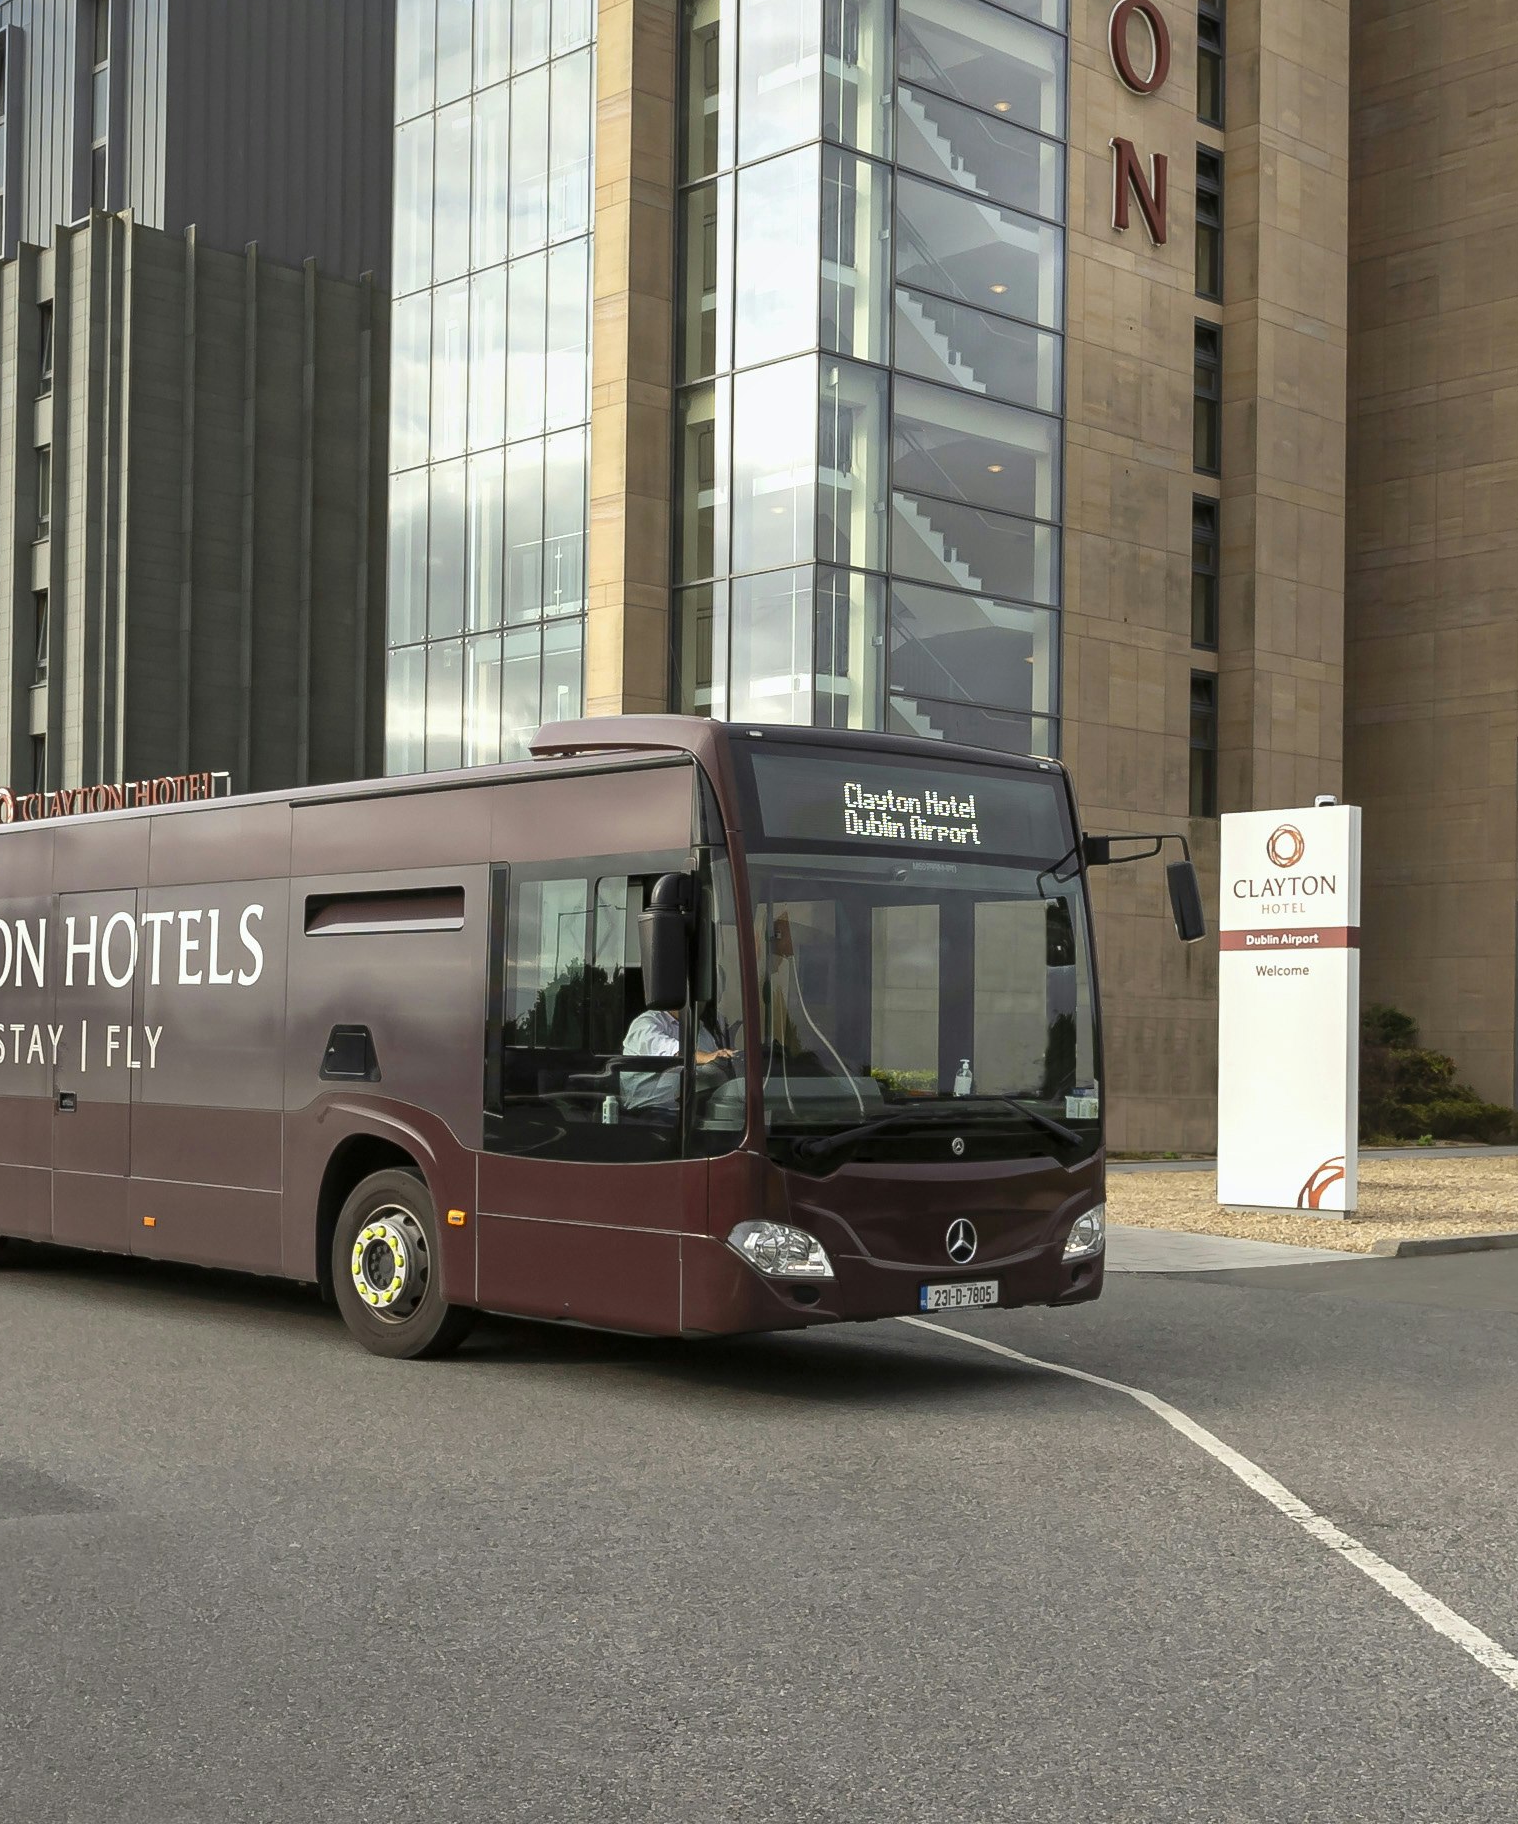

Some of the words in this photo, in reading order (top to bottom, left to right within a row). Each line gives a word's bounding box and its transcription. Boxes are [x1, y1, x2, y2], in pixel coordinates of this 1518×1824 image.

[844, 782, 921, 813] Clayton
[925, 790, 976, 818] Hotel
[844, 809, 906, 838] Dublin
[910, 815, 981, 844] Airport
[1233, 875, 1336, 898] CLAYTON
[1261, 903, 1306, 914] HOTEL
[65, 903, 264, 988] HOTELS
[1246, 934, 1279, 945] Dublin
[1280, 933, 1319, 946] Airport
[1255, 965, 1310, 976] Welcome
[106, 1025, 163, 1068] FLY
[934, 1286, 992, 1307] 231-D-7805
